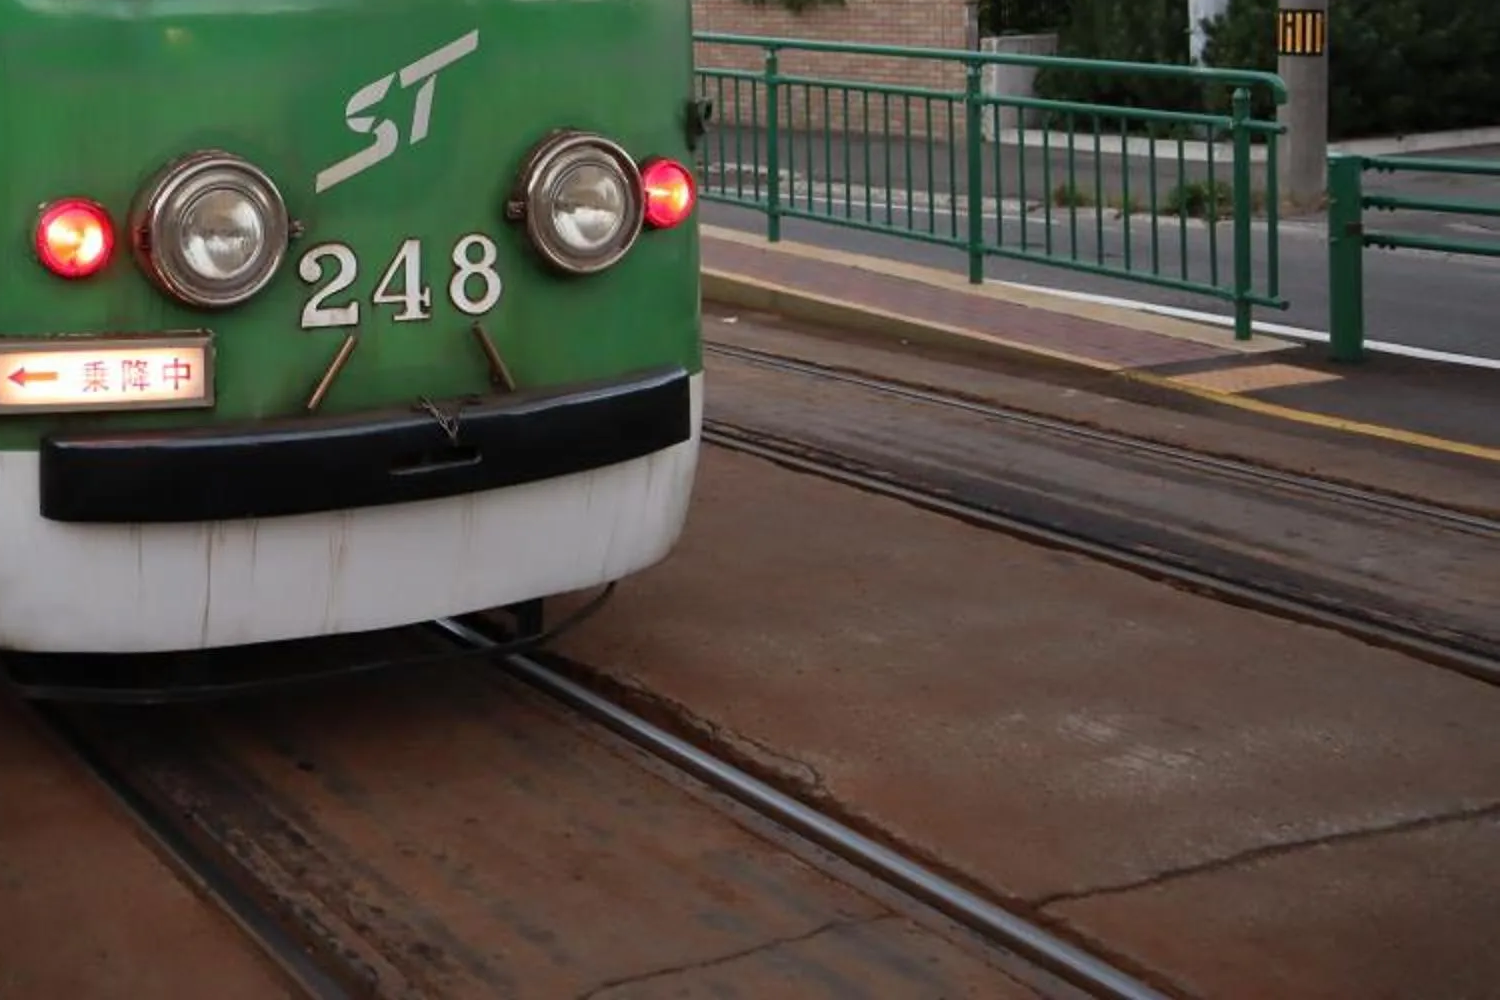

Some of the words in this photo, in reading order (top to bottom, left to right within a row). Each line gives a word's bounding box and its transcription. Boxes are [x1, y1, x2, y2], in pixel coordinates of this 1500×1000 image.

[315, 29, 480, 194] ST
[299, 234, 502, 328] 248
[82, 358, 191, 392] 乗降中
